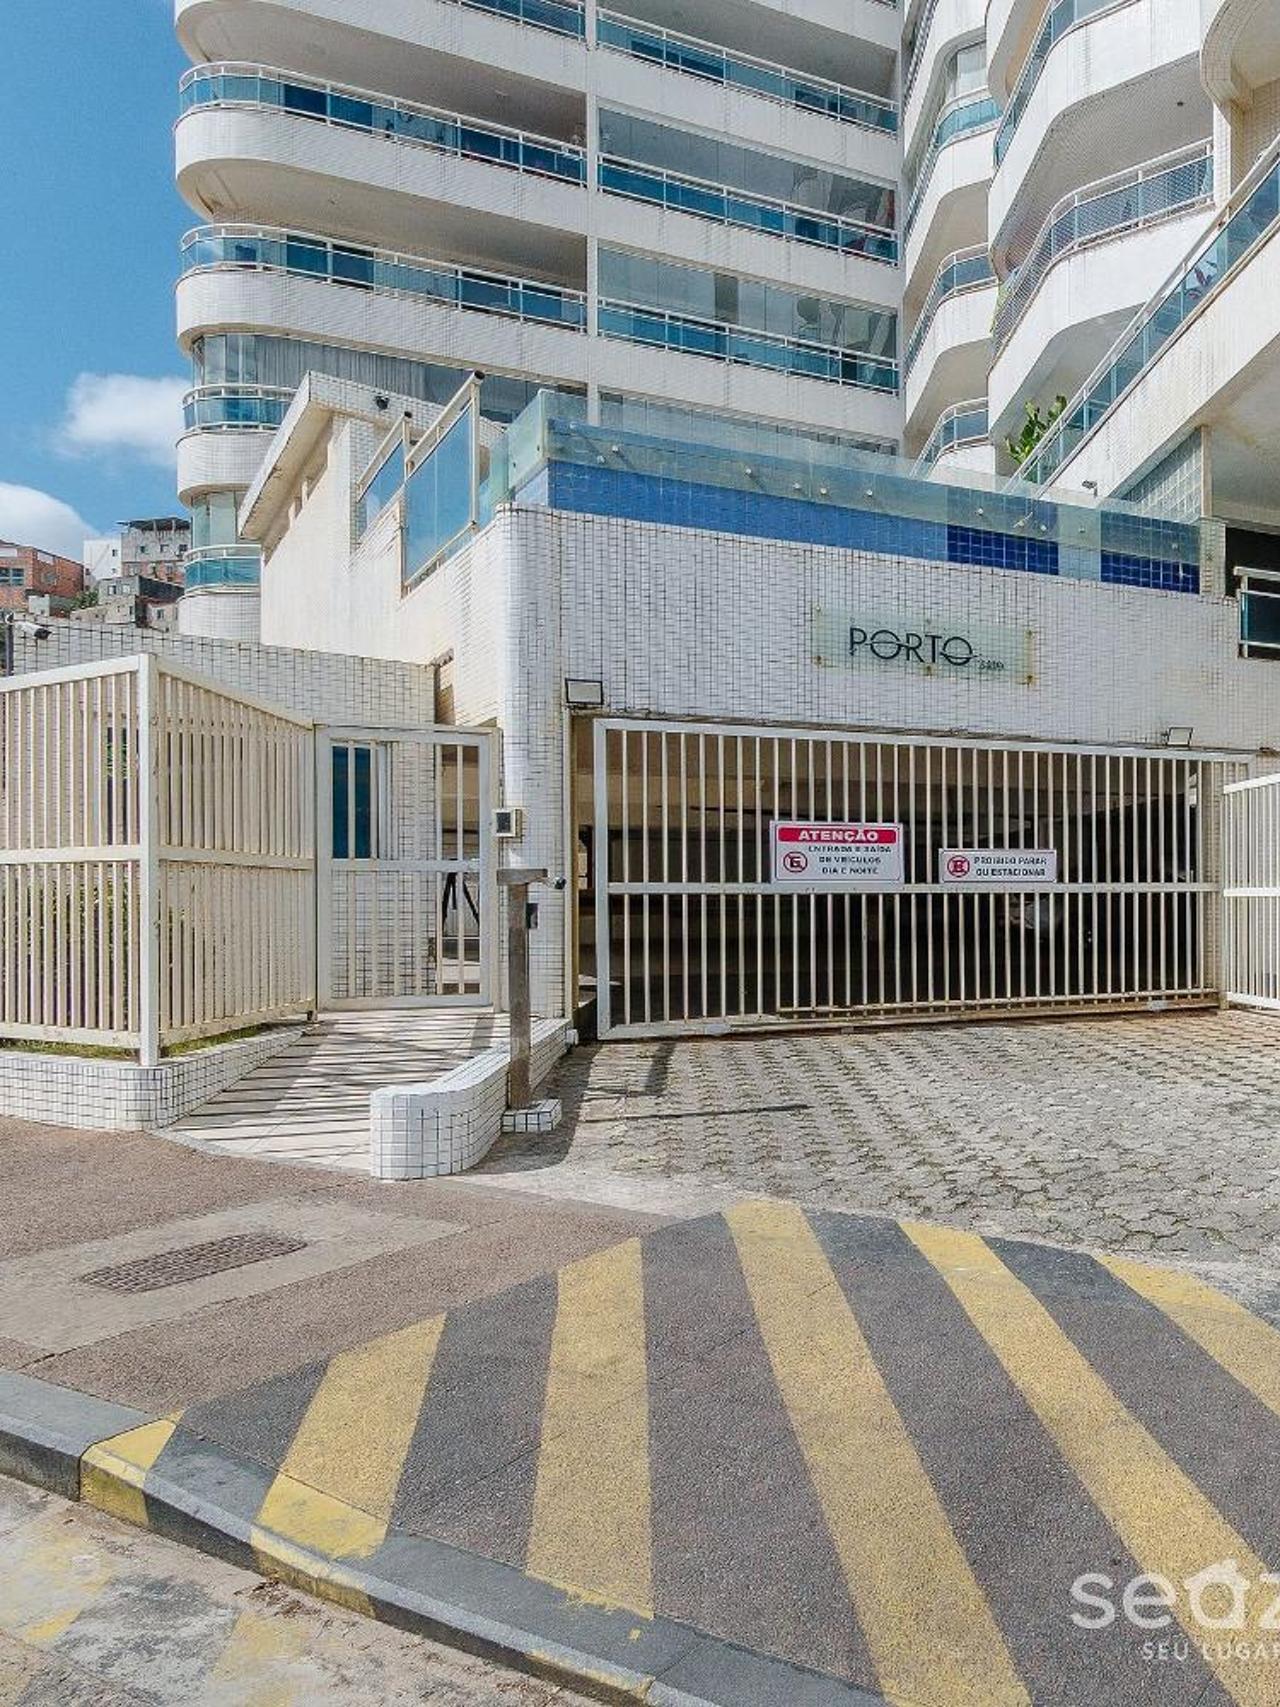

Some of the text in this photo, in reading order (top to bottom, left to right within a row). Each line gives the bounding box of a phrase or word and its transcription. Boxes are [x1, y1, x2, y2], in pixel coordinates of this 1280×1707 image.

[849, 627, 978, 666] PORTO
[798, 828, 879, 843] ATENÇÃO
[973, 856, 1047, 865] PROIBIDO PARAR
[850, 867, 879, 875] NOITE
[976, 868, 1046, 876] OU ESTACIONAR
